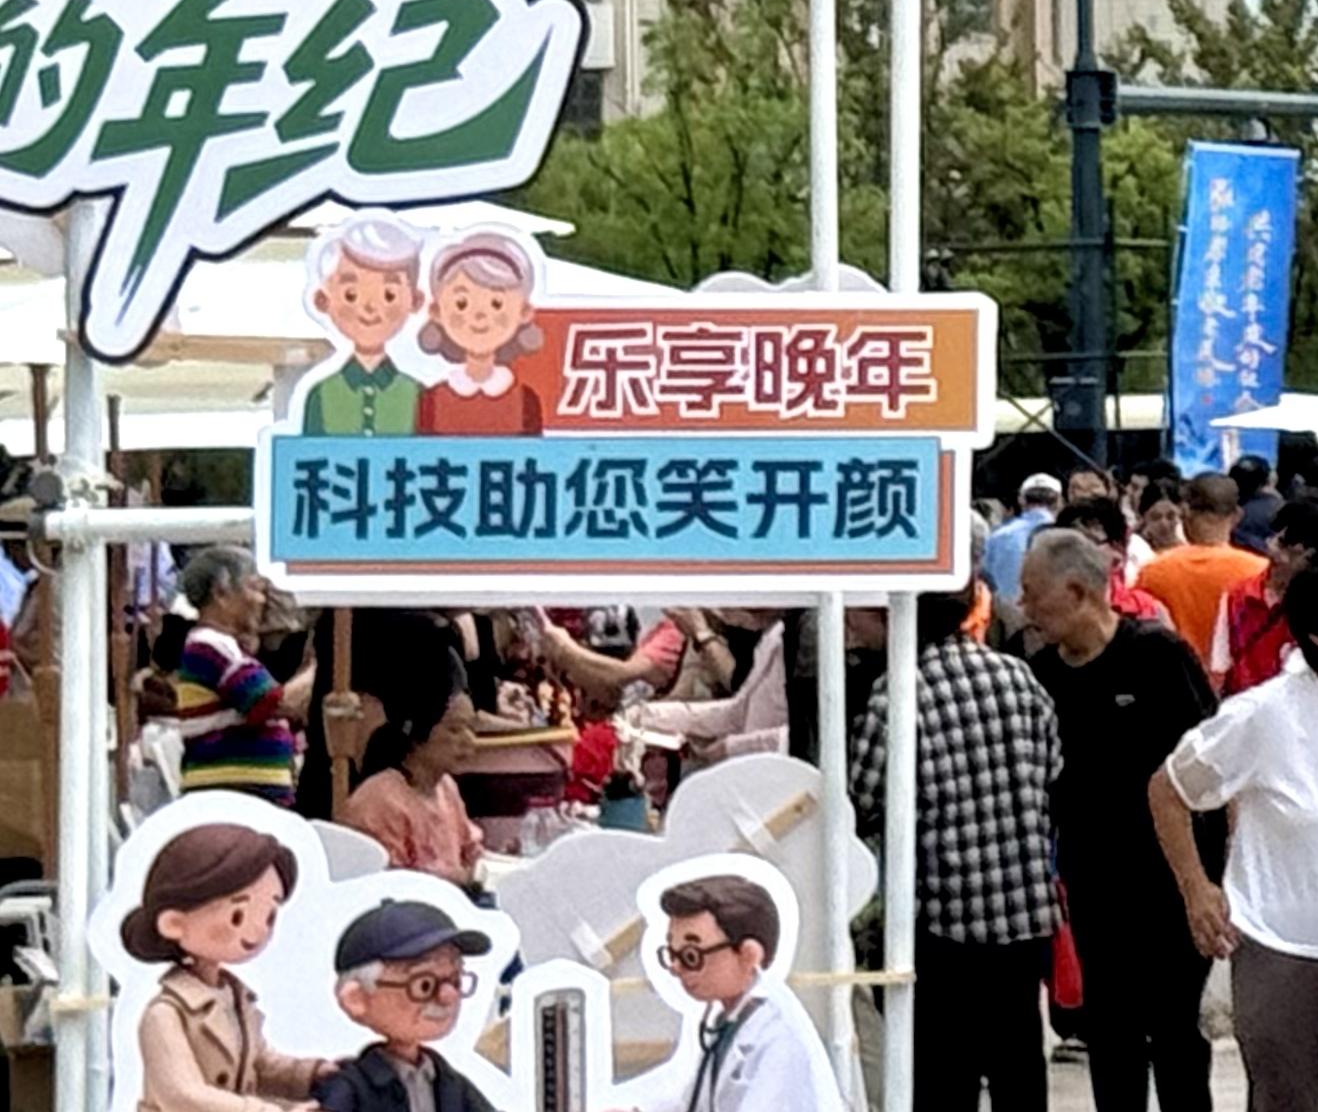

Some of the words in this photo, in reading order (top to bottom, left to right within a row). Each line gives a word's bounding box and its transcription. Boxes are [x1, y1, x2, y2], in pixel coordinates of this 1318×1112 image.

[557, 322, 937, 420] 乐享晚年
[291, 456, 920, 541] 科技助您笑开颜
